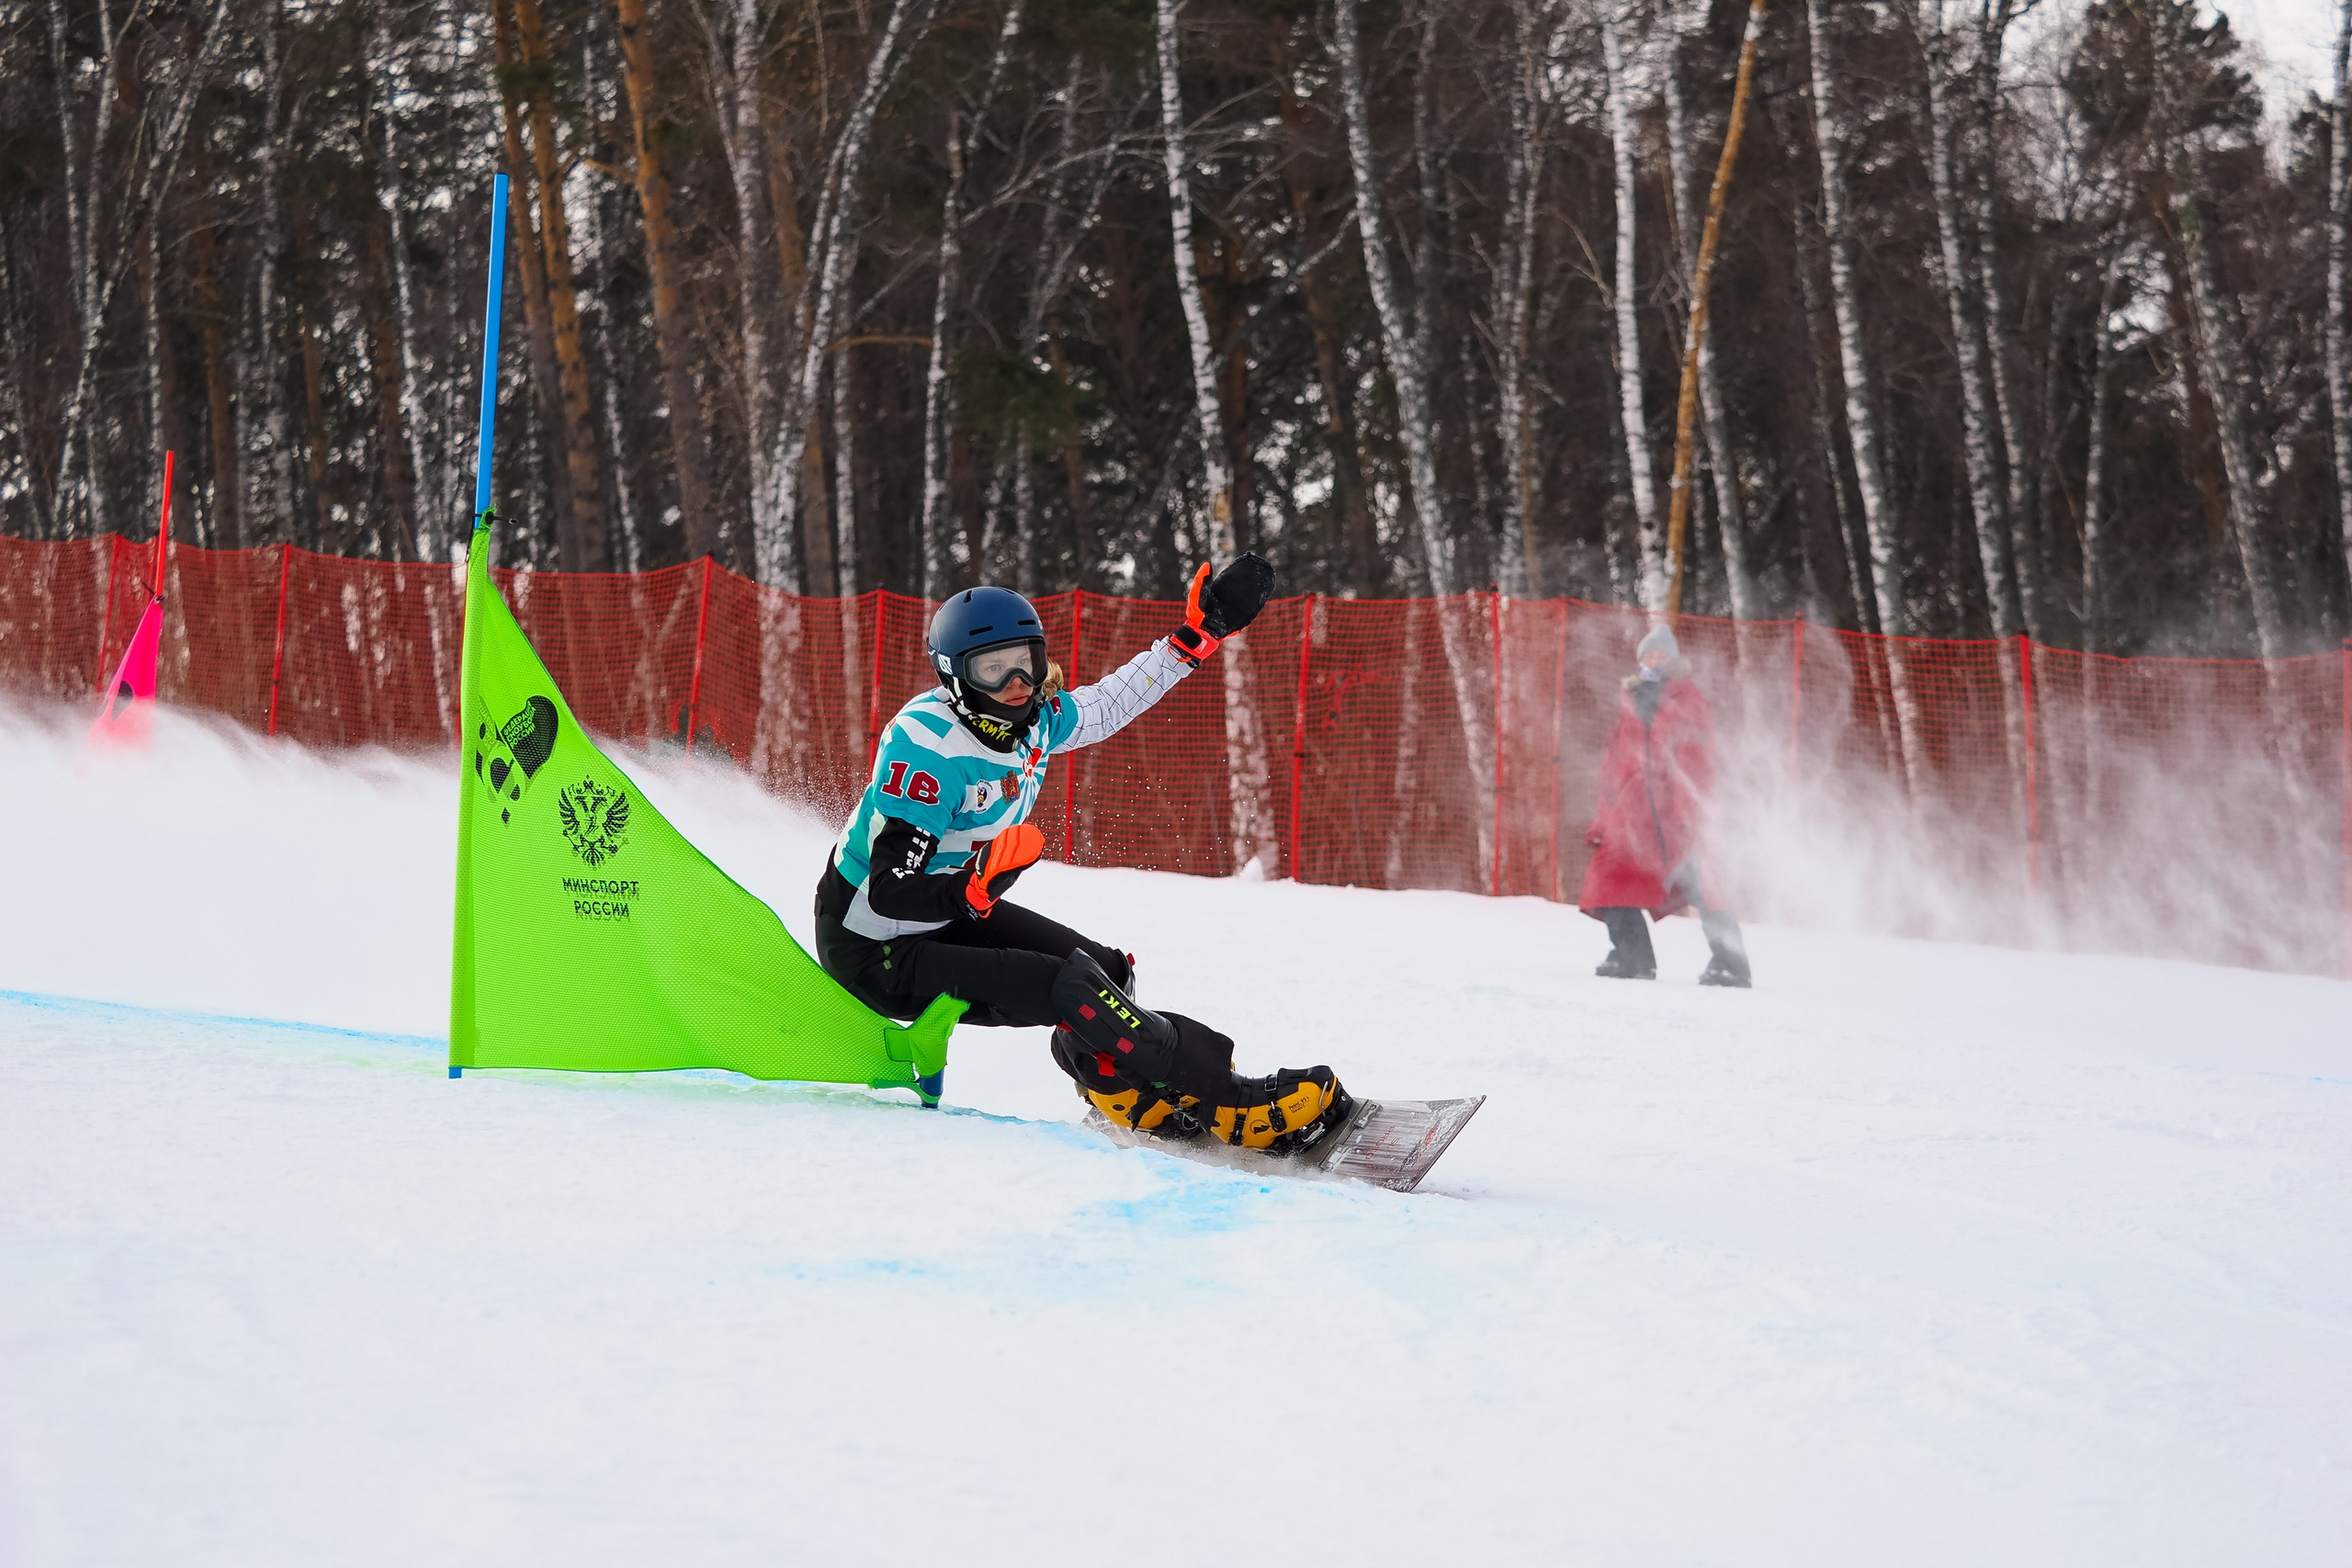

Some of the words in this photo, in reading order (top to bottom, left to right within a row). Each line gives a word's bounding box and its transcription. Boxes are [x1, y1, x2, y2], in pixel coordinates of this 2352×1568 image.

[562, 877, 639, 895] МИНСПОРТ
[574, 900, 629, 917] РОССИИ
[1098, 989, 1141, 1029] LEKI
